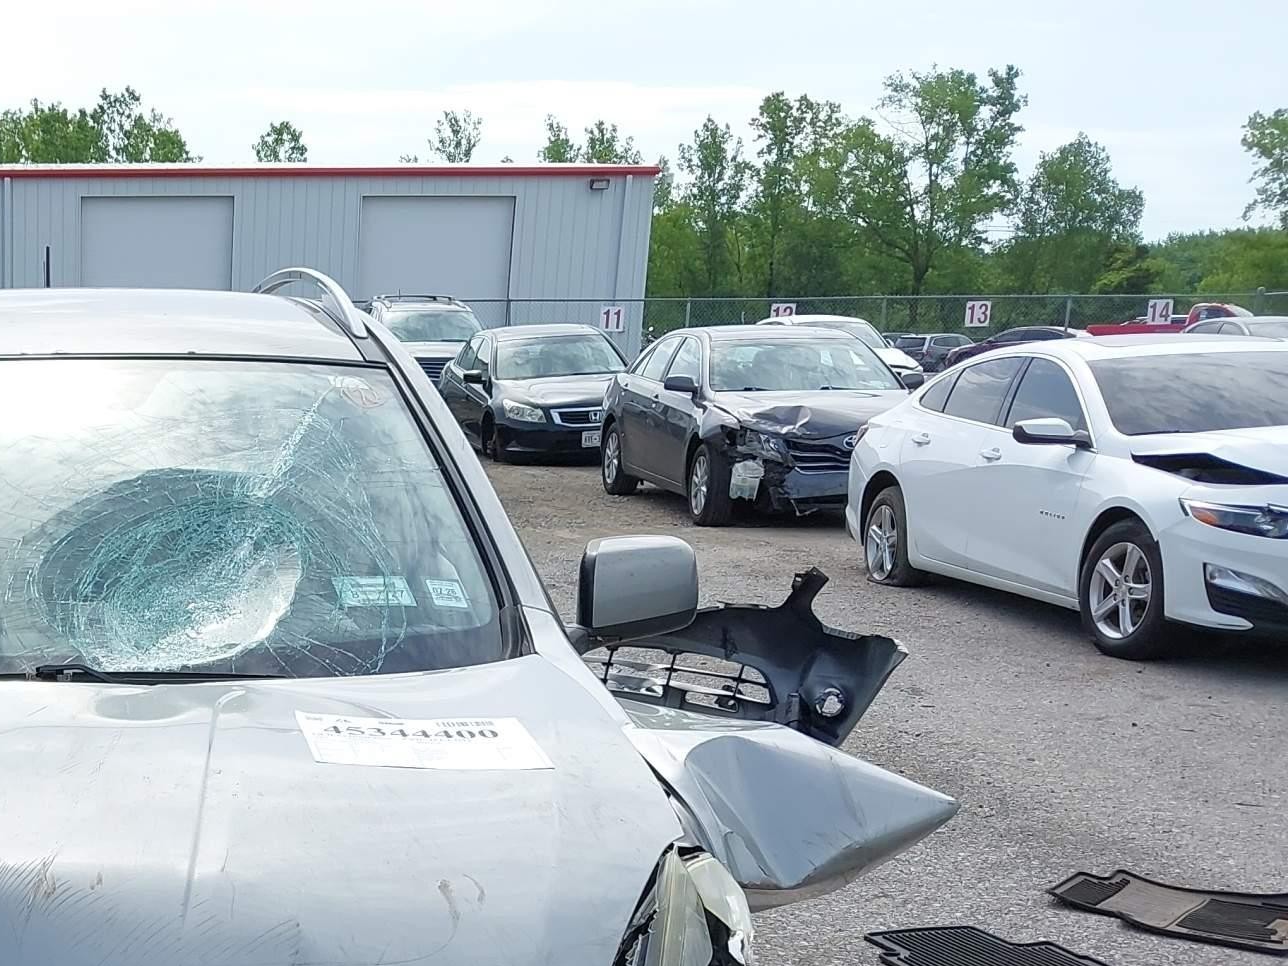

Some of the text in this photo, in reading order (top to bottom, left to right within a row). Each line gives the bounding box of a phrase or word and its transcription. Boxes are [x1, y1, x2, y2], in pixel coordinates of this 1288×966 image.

[603, 308, 621, 329] 11
[968, 303, 989, 324] 13
[1149, 301, 1170, 322] 14
[323, 725, 499, 739] 45344400
